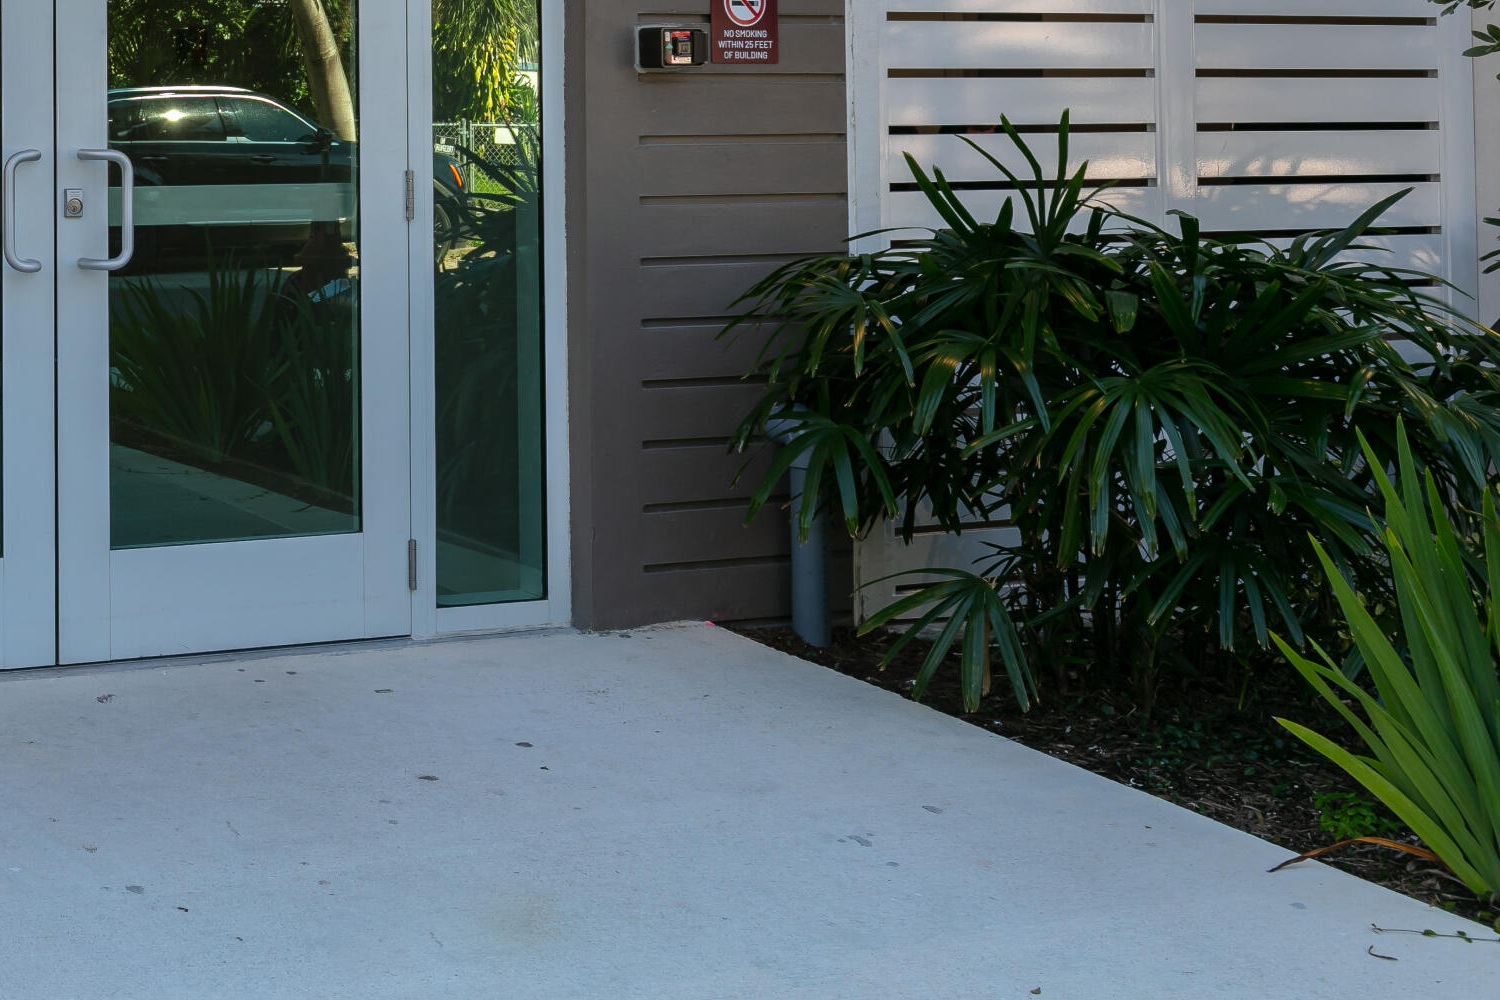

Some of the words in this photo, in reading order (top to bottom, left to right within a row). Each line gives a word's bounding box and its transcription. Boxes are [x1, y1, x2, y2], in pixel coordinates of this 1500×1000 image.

[723, 29, 734, 38] NO
[735, 29, 768, 38] SMOKING
[717, 40, 744, 49] WITHIN
[744, 40, 754, 49] 25
[754, 40, 773, 49] FEET
[723, 51, 734, 59] OF
[734, 51, 768, 59] BUILDING
